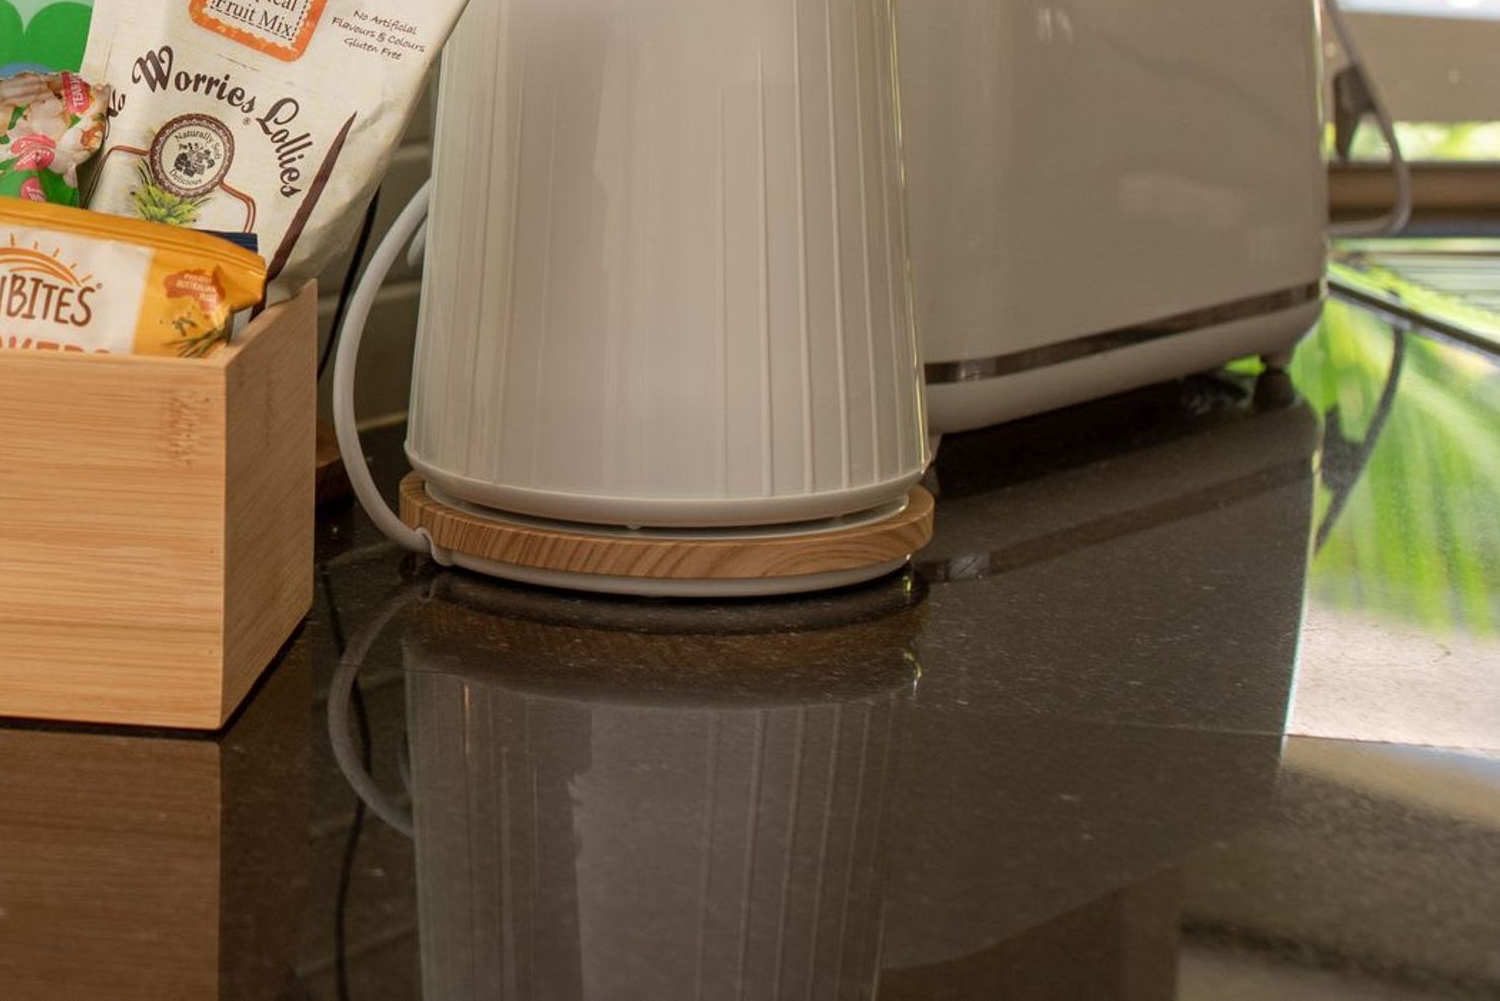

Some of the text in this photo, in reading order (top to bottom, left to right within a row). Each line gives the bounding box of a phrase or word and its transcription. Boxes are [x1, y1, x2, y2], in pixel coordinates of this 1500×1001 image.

[258, 10, 293, 37] Mix
[331, 16, 376, 38] Flavours
[387, 34, 426, 53] Colours
[353, 10, 417, 35] No Artificial
[343, 37, 403, 61] Gluten Free
[131, 45, 257, 114] Worries
[256, 97, 313, 198] Lollies
[174, 130, 213, 144] Naturally
